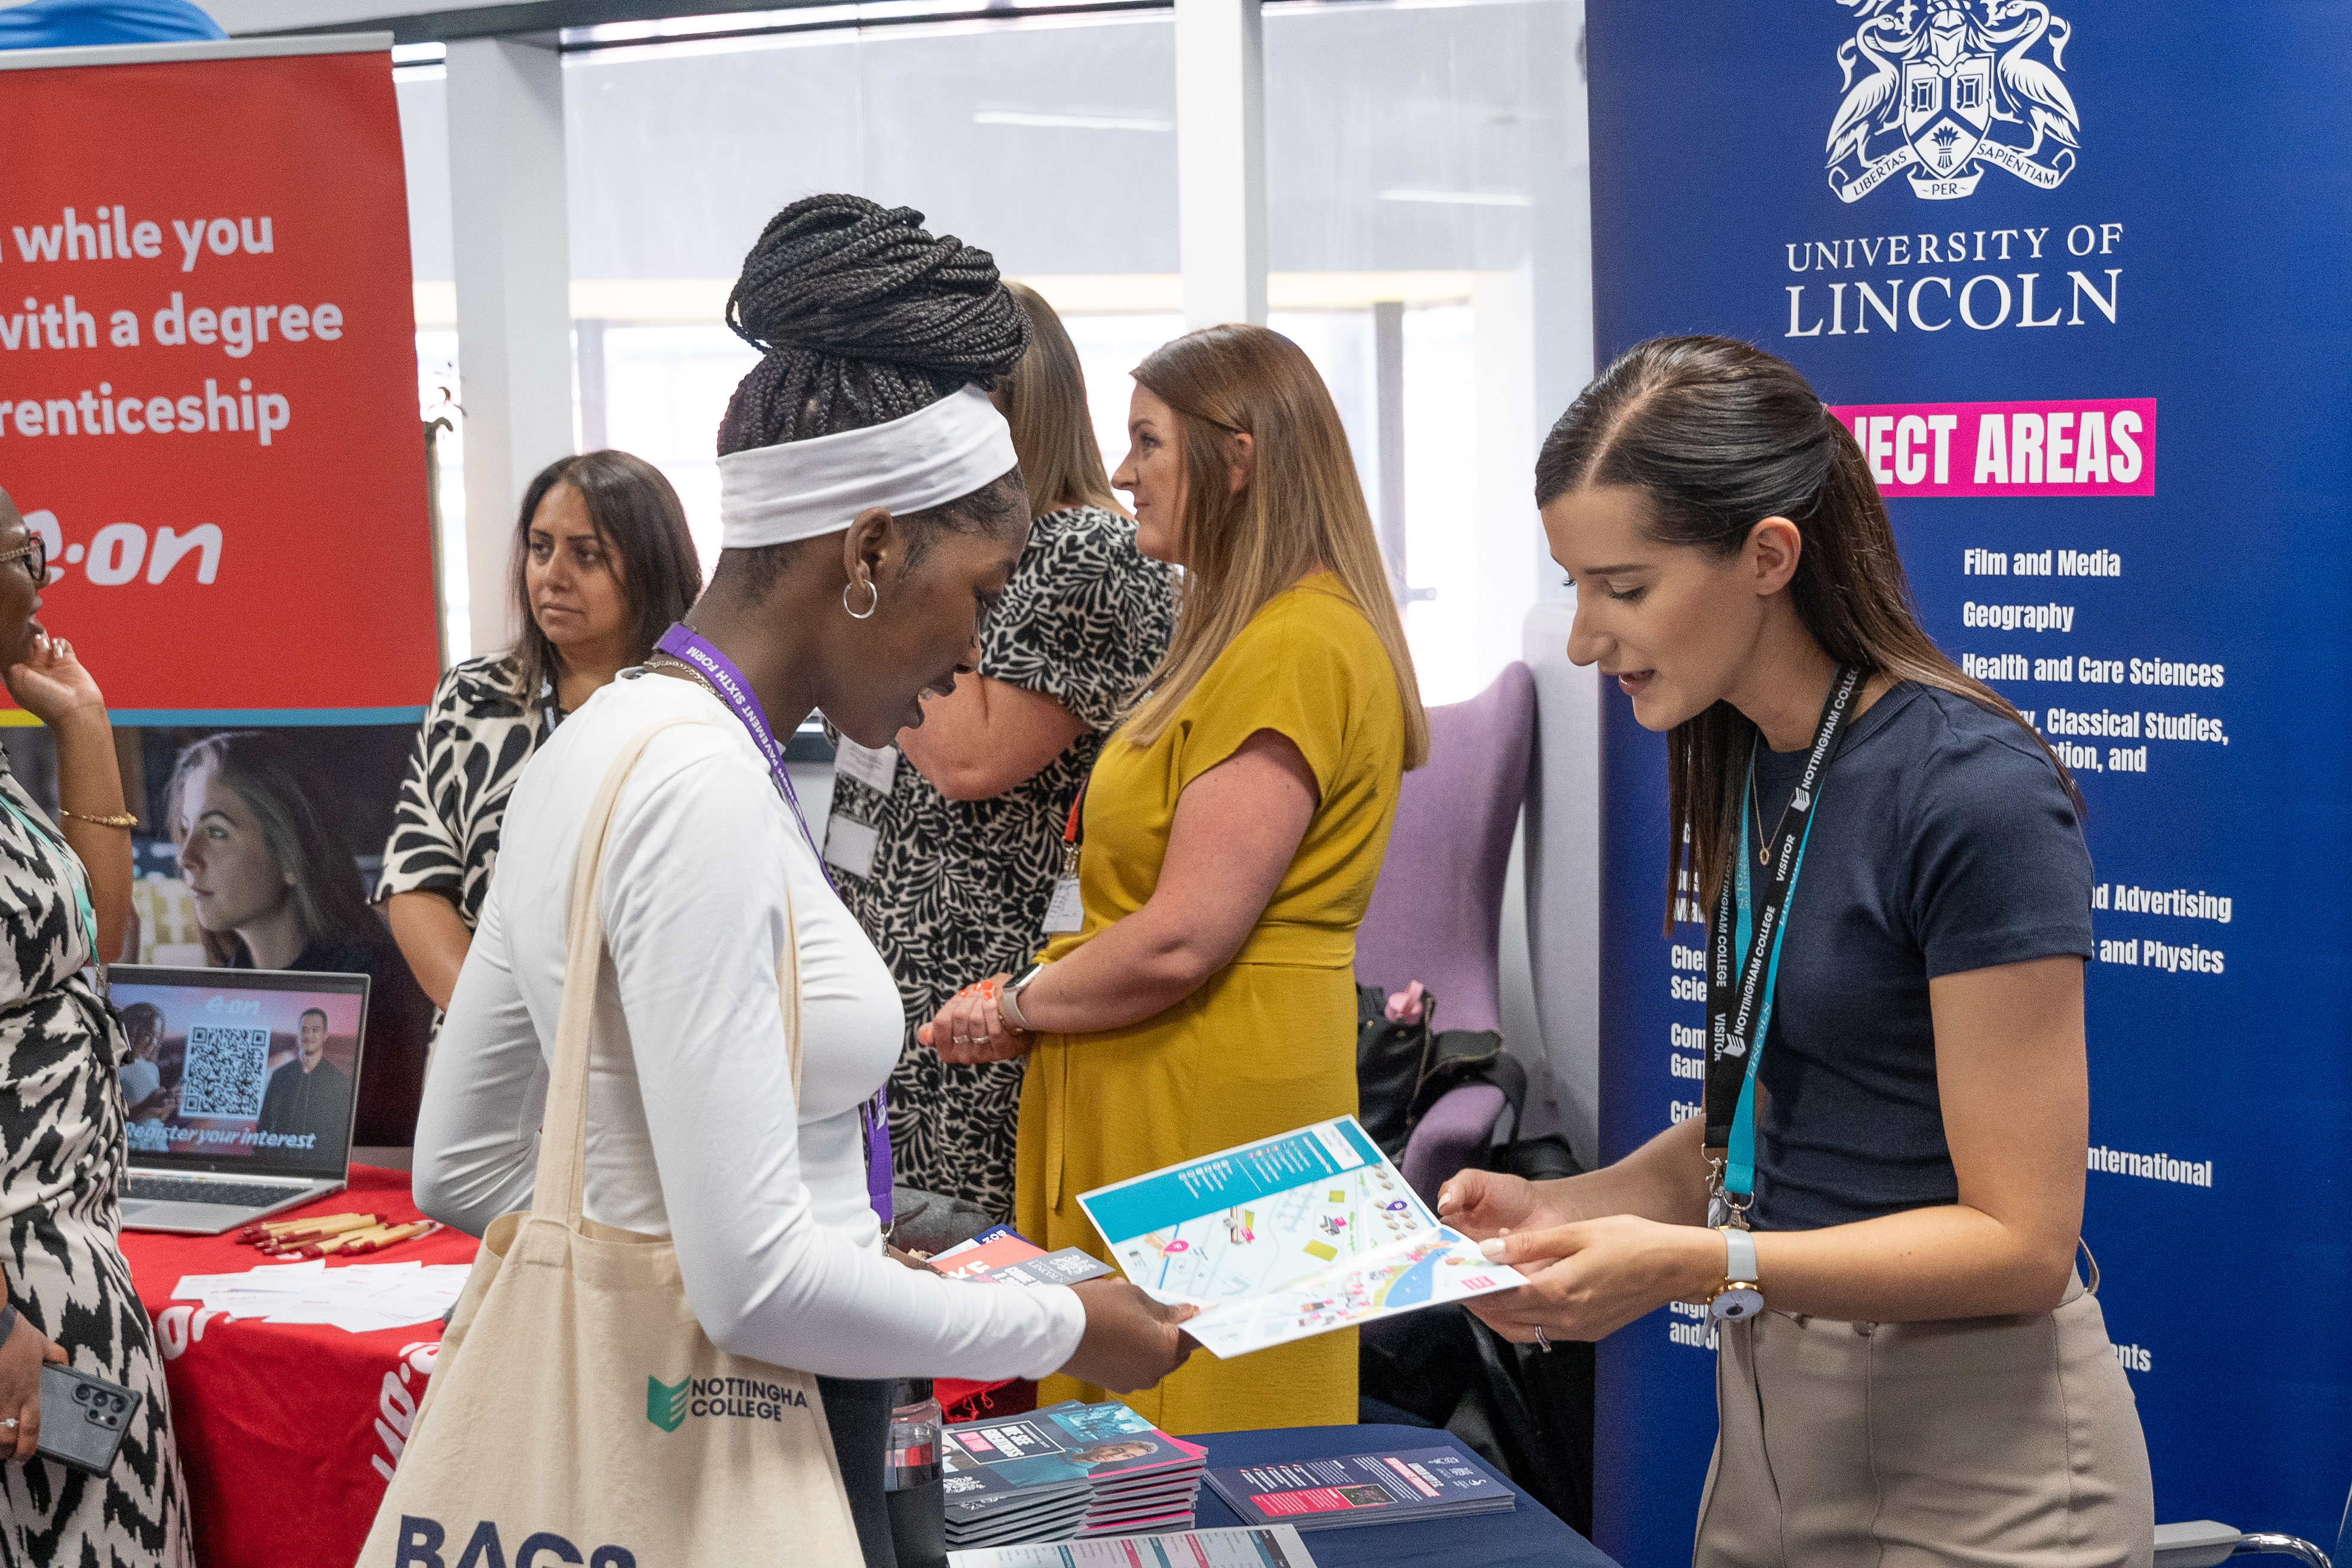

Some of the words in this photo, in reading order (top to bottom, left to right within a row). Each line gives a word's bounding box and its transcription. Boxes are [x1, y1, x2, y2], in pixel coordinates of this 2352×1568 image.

[1852, 151, 1907, 196] LIBERTAS
[1977, 143, 2056, 186] SAPIENTIAM
[13, 206, 163, 262] while
[173, 216, 274, 272] you
[1786, 227, 2050, 272] UNIVERSITY
[2066, 222, 2124, 256] OF
[1784, 269, 2124, 338] LINCOLN
[110, 309, 140, 347] a
[153, 292, 344, 358] degree
[1974, 411, 2143, 484] AREAS
[1964, 549, 2007, 575] Film
[2013, 549, 2051, 576] and
[2057, 549, 2121, 577] Media
[1962, 601, 2075, 633] Geography
[686, 645, 720, 672] FORM
[1962, 654, 2029, 681] Health
[2034, 656, 2072, 682] and
[2078, 656, 2124, 684] Care
[2129, 657, 2225, 688] Sciences
[715, 669, 746, 706] SIXTH
[741, 704, 779, 767] PAVEMENT
[2047, 708, 2139, 739] Classical
[2145, 714, 2229, 745] Studies,
[1801, 709, 1840, 789] NOTTINGHAM
[2108, 746, 2146, 771] and
[1776, 834, 1796, 883] VISITOR
[2114, 884, 2232, 923] Advertising
[1716, 933, 1729, 988] COLLEGE
[1734, 957, 1763, 1036] NOTTINGHAM
[1756, 905, 1776, 958] COLLEGE
[2100, 939, 2137, 966] and
[2143, 940, 2225, 974] Physics
[240, 1128, 317, 1150] interest
[2087, 1145, 2212, 1188] nternational
[1670, 1322, 1701, 1348] and
[691, 1398, 782, 1422] COLLEGE
[692, 1377, 808, 1408] NOTTINGHA
